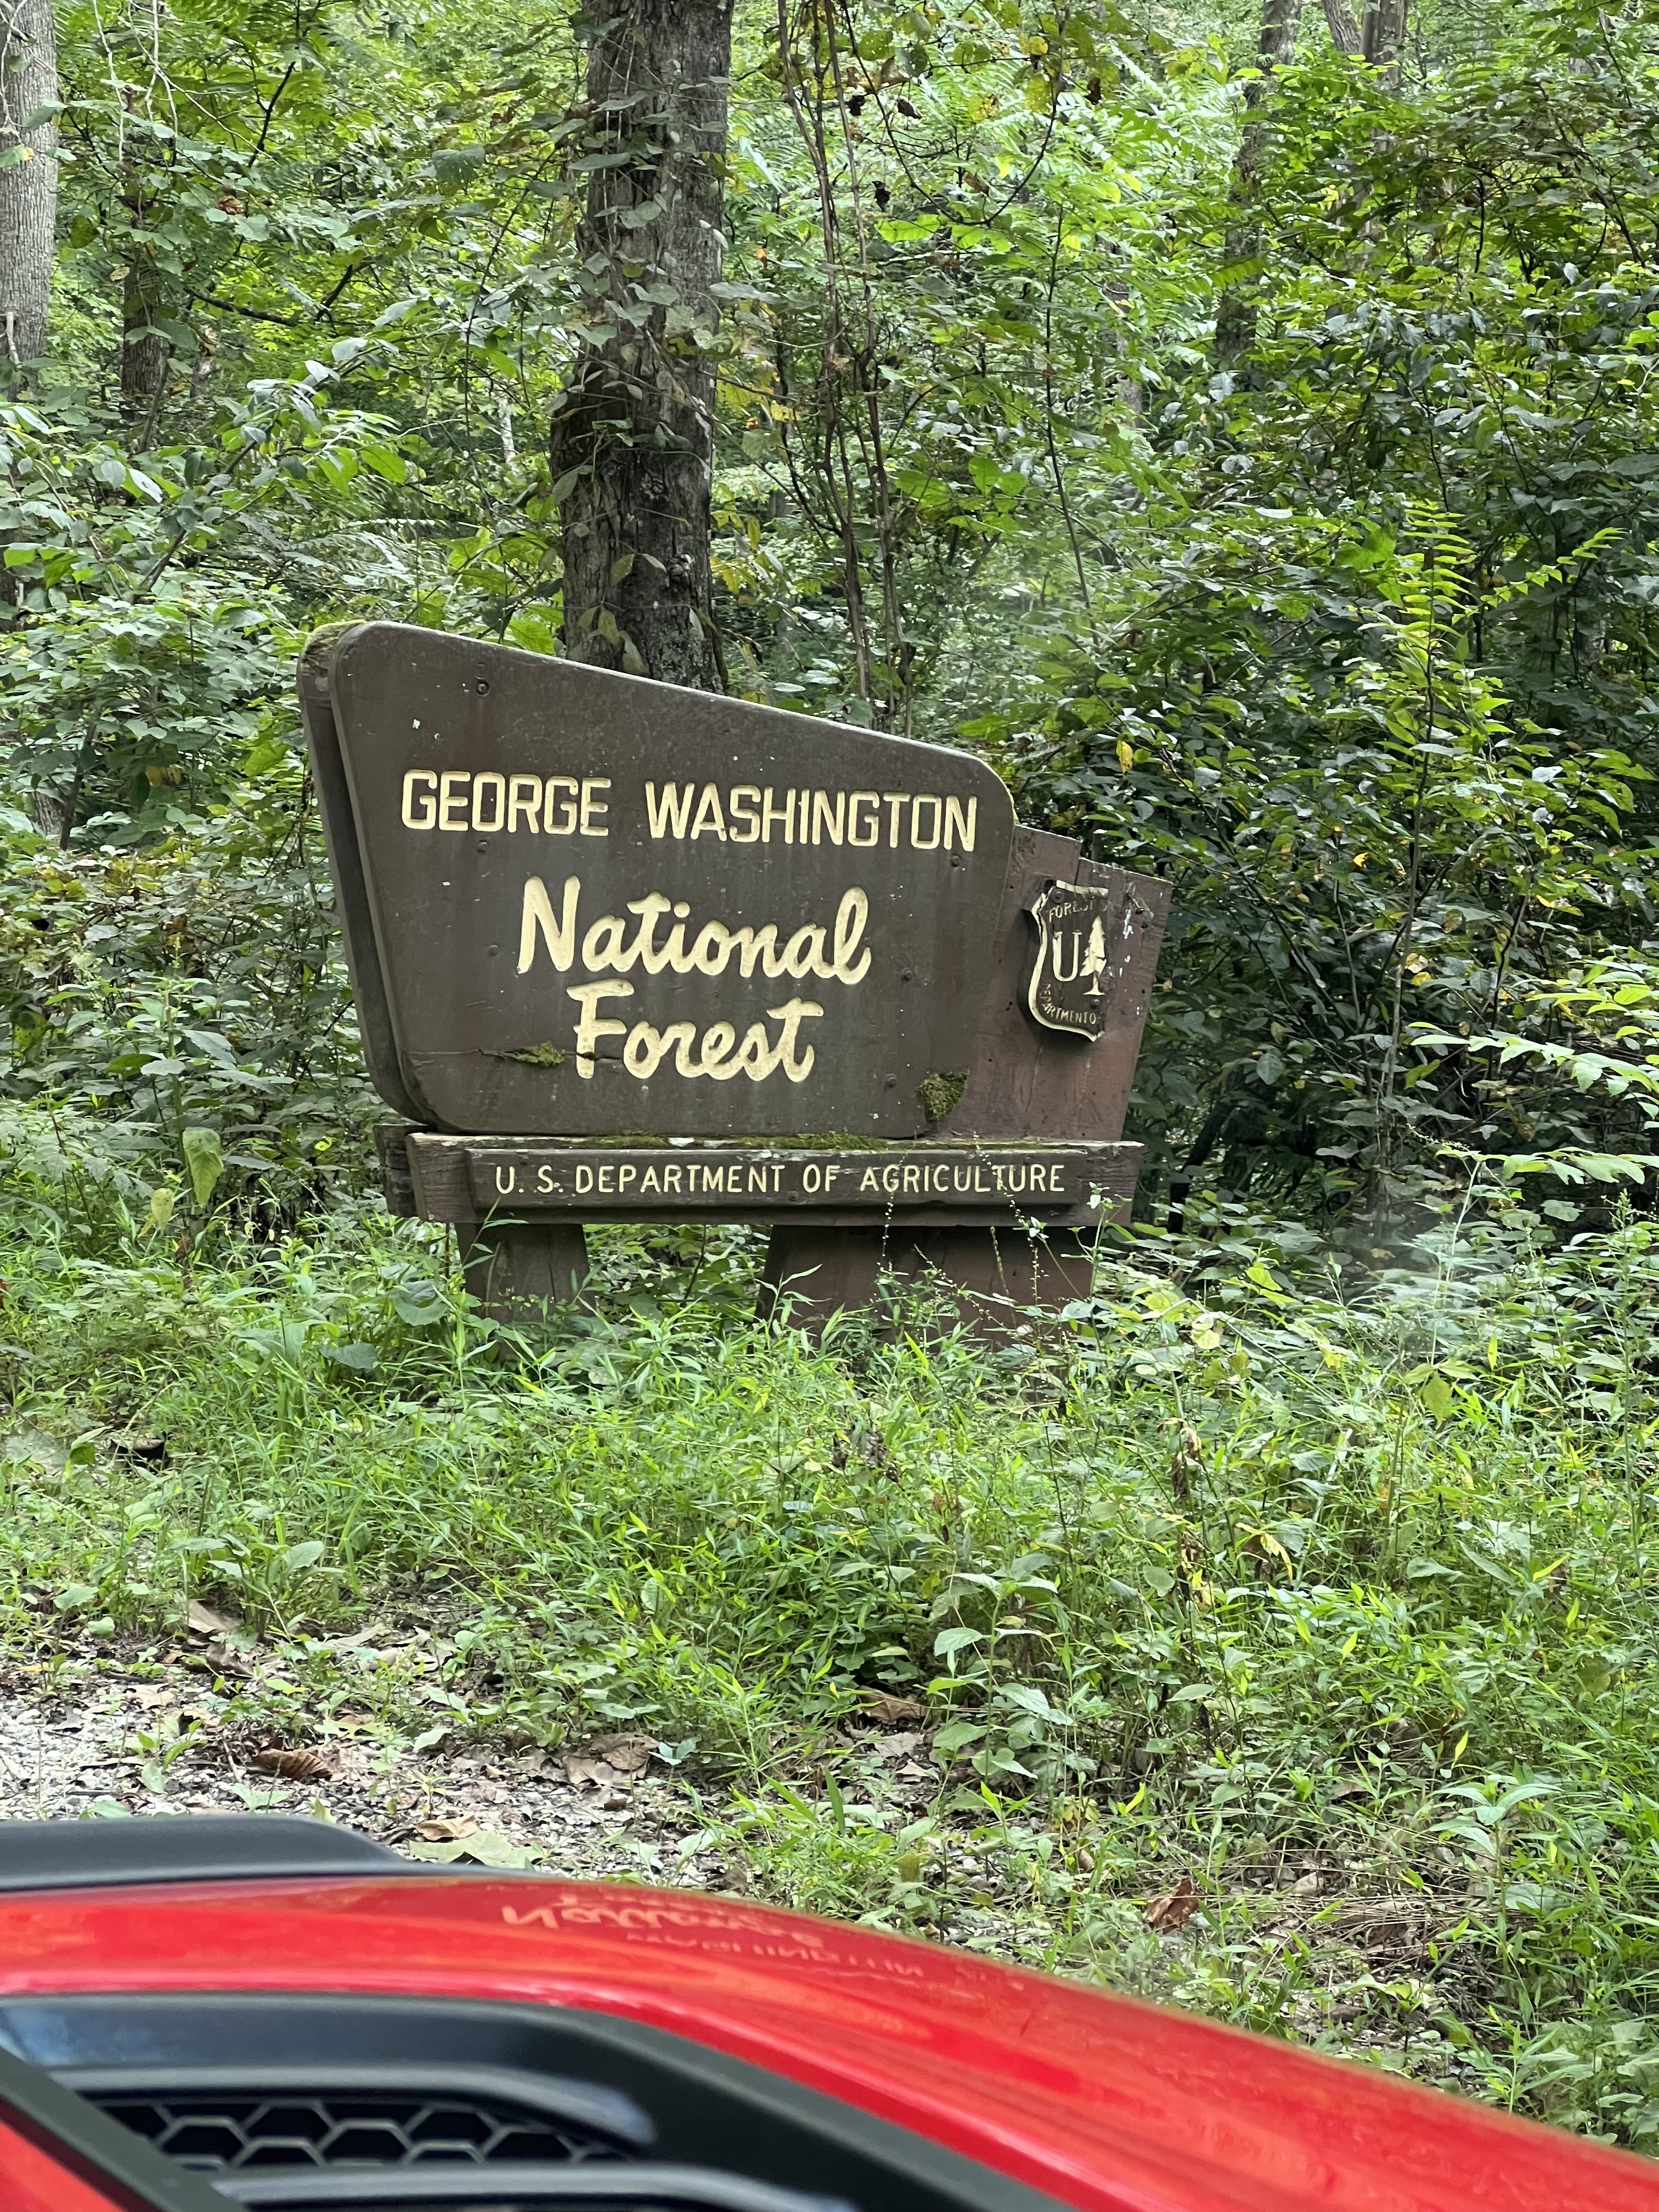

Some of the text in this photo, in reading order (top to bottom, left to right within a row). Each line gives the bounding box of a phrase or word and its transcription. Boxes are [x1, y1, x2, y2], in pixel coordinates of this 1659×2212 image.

[402, 769, 977, 852] GEORGE WASHINGTON
[516, 876, 872, 985] National
[1048, 899, 1093, 923] FOREST
[566, 979, 825, 1084] Forest
[1039, 983, 1089, 1024] DEPARTMENT
[575, 1164, 783, 1193] DEPARTMENT
[803, 1164, 839, 1193] OF
[859, 1163, 1065, 1195] AGRICULTURE
